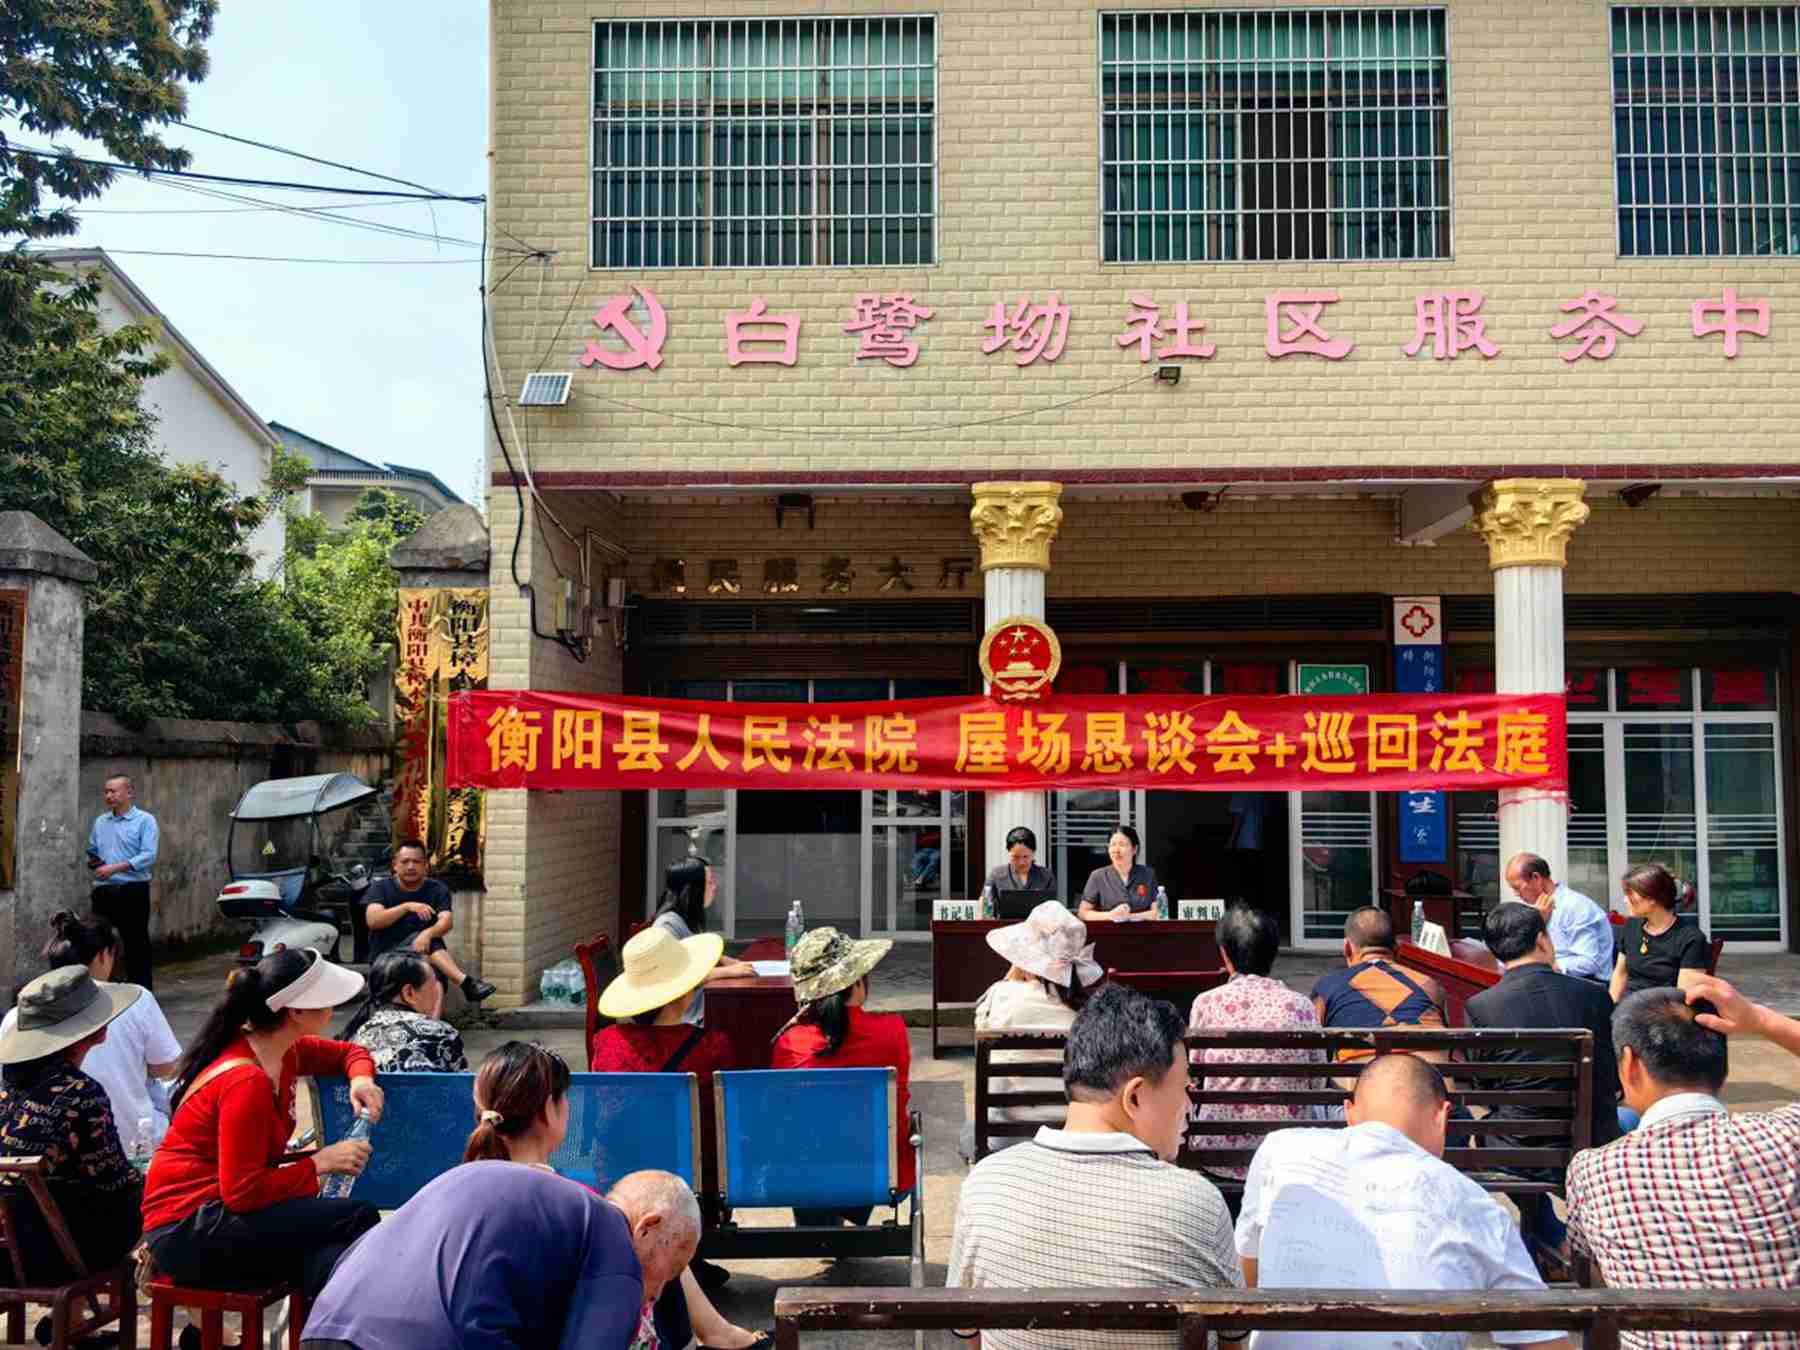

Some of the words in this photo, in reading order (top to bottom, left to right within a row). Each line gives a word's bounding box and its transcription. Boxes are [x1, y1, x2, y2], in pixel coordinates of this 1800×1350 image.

[725, 288, 1771, 368] 白鹭坳社区服务中
[486, 704, 918, 774] 衡阳县人民法院
[955, 709, 1550, 774] 屋场恳谈会+巡回法庭
